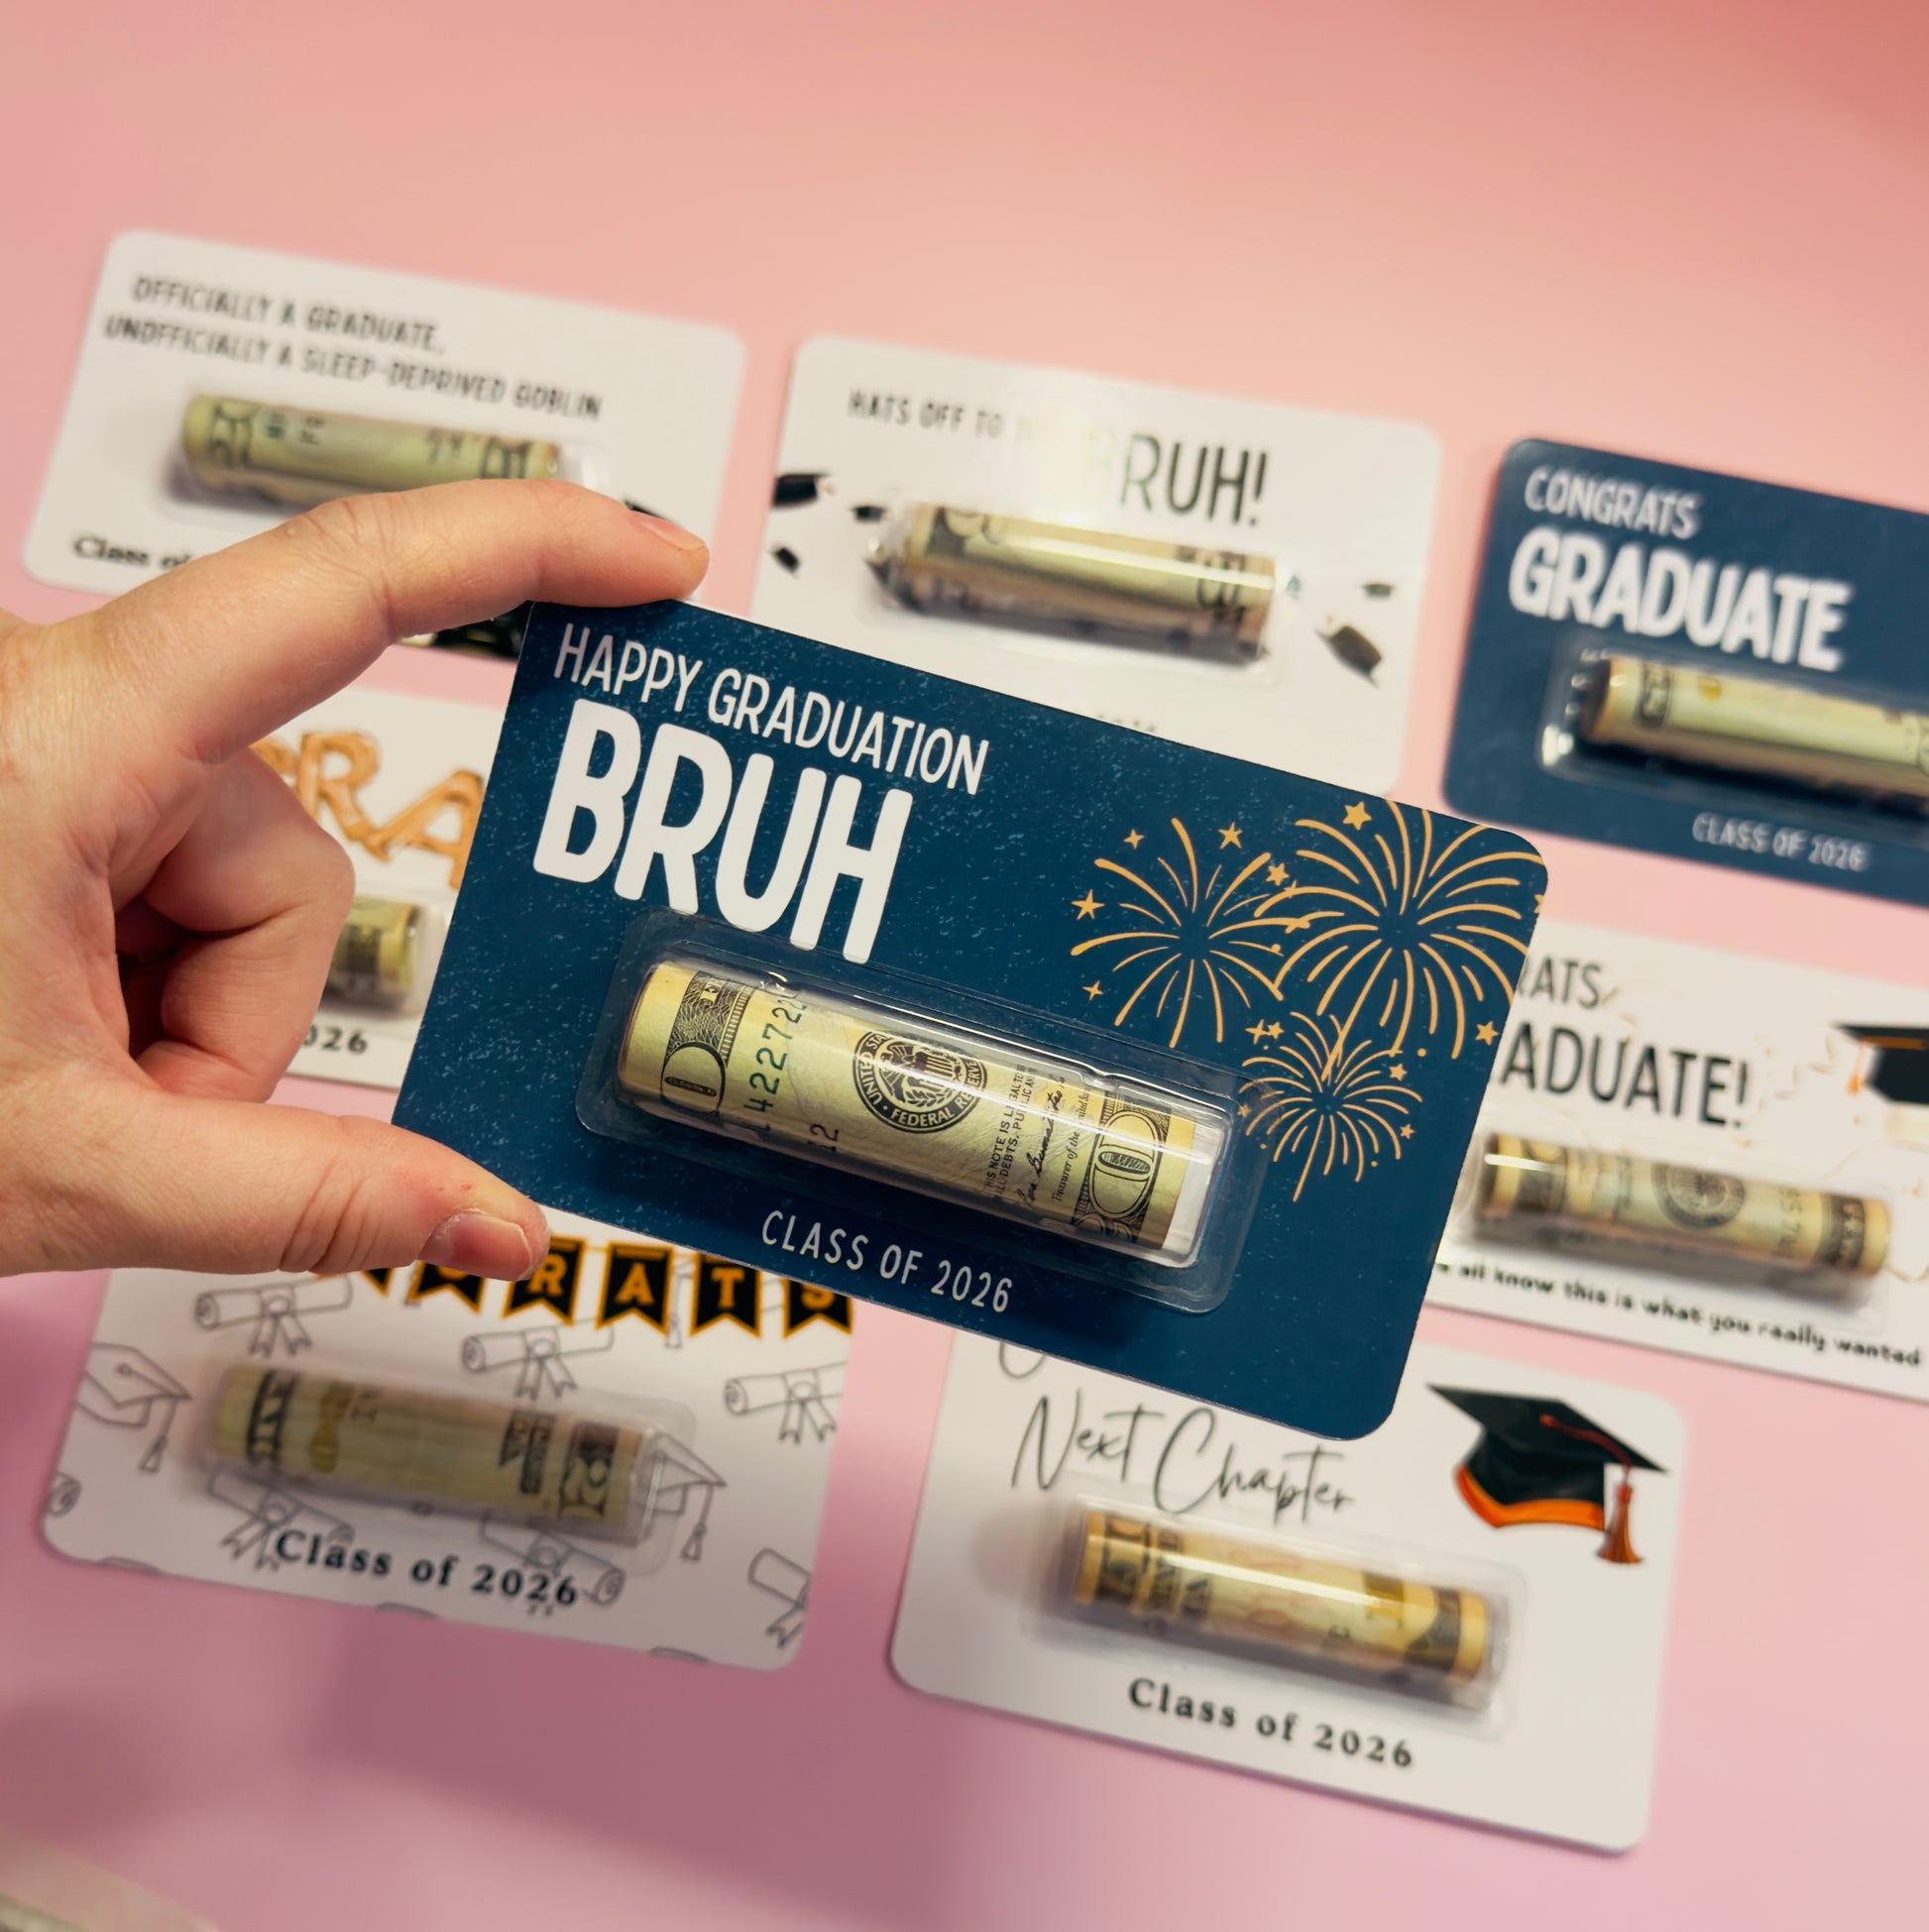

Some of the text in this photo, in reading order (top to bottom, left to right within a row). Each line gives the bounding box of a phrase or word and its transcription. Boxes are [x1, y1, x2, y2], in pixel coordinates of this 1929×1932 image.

[133, 275, 447, 355] OFFICIALLY A GRADUATE,
[105, 314, 603, 421] UNOFFICIALLY A SLEEP-DEPRIVED GOBLIN
[848, 391, 910, 425] HATS
[919, 398, 964, 432] OFF
[975, 409, 1005, 439] TO
[1524, 466, 1701, 539] CONGRATS
[1508, 526, 1853, 672] GRADUATE
[553, 623, 989, 795] HAPPY GRADUATION
[532, 698, 914, 965] BRUH
[1692, 811, 1870, 871] CLASS OF 2026
[890, 1109, 956, 1128] FEDERAL
[955, 1060, 979, 1109] REERVE
[990, 1137, 1004, 1170] NOTE
[999, 1120, 1010, 1134] IS
[1067, 1147, 1078, 1160] of
[1071, 1131, 1080, 1147] the
[1052, 1162, 1072, 1201] Treasurer
[761, 1210, 1013, 1313] CLASS OF 2026
[1460, 1263, 1485, 1281] all
[1494, 1266, 1554, 1294] know
[1563, 1280, 1606, 1304] this
[1615, 1290, 1633, 1309] is
[1643, 1297, 1701, 1321] what
[1710, 1312, 1751, 1332] you
[1759, 1323, 1825, 1352] really
[1834, 1339, 1921, 1367] wanted
[1011, 1389, 1355, 1525] Next Chapter
[276, 1530, 577, 1607] Class of 2026
[1128, 1677, 1415, 1768] Class of 2026
